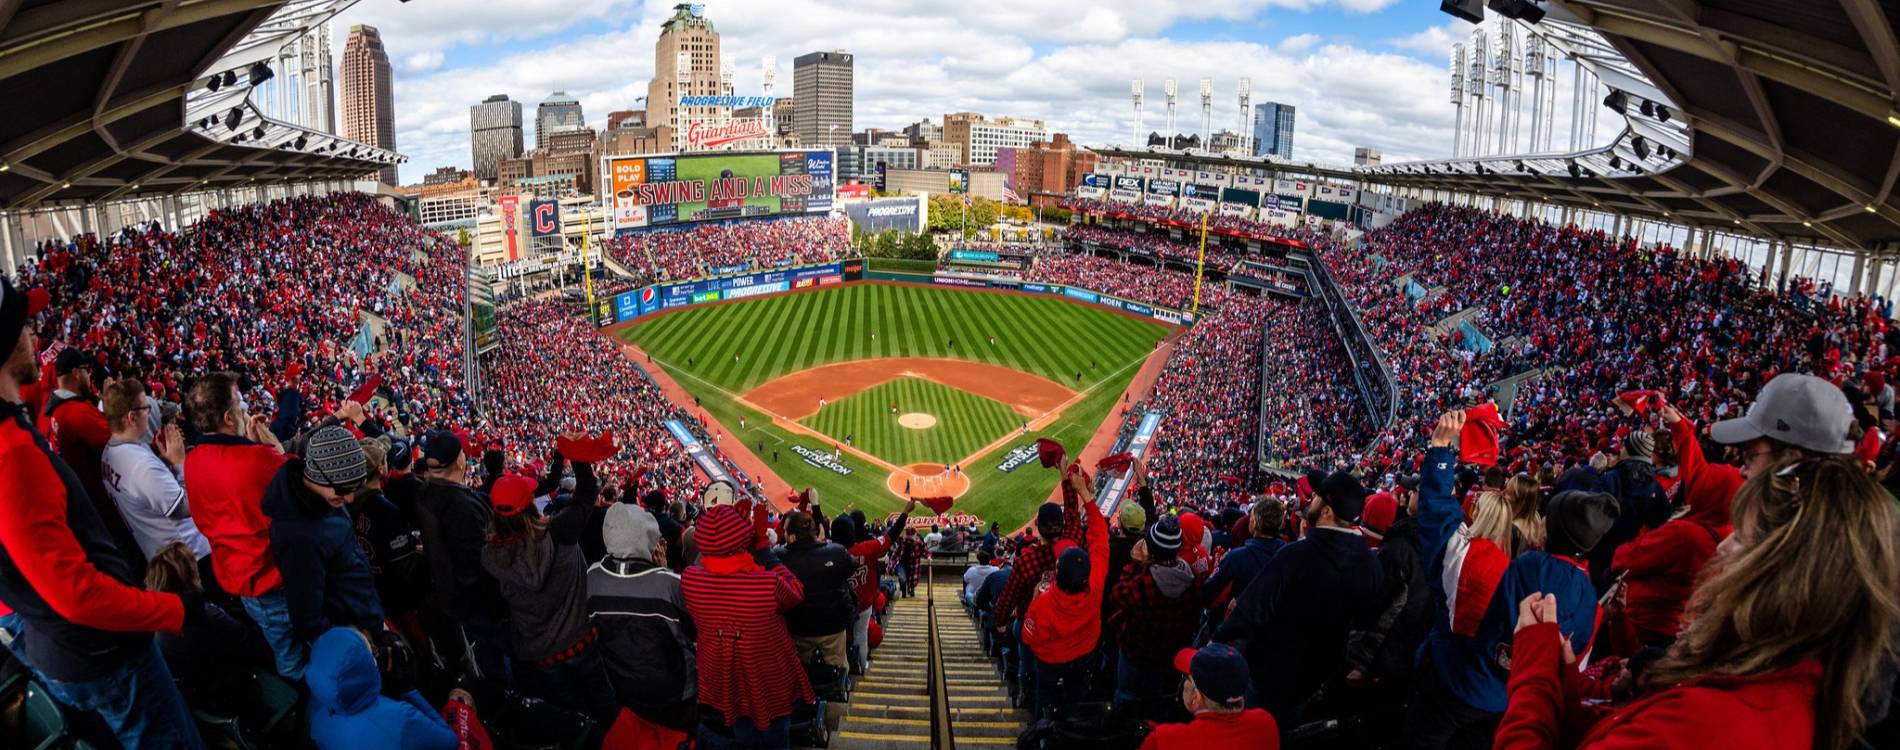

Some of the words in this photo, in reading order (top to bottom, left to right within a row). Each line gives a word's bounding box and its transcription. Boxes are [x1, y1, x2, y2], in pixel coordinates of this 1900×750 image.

[680, 96, 744, 106] PROGRESSIVE
[747, 96, 774, 106] FIELD
[688, 120, 767, 147] Guardians
[616, 165, 640, 174] BOLD
[617, 174, 640, 182] PLAY
[1118, 178, 1139, 187] DEX
[639, 180, 704, 206] SWING
[710, 177, 749, 201] AND
[753, 177, 768, 197] A
[770, 174, 813, 197] MISS
[867, 205, 917, 217] PROGRESSIVE
[535, 203, 555, 233] C
[707, 281, 720, 291] LIVE
[732, 276, 754, 287] POWER
[729, 282, 783, 298] PROGRESSIVE
[1100, 296, 1122, 308] MOEN
[791, 445, 852, 475] POSTSEASON
